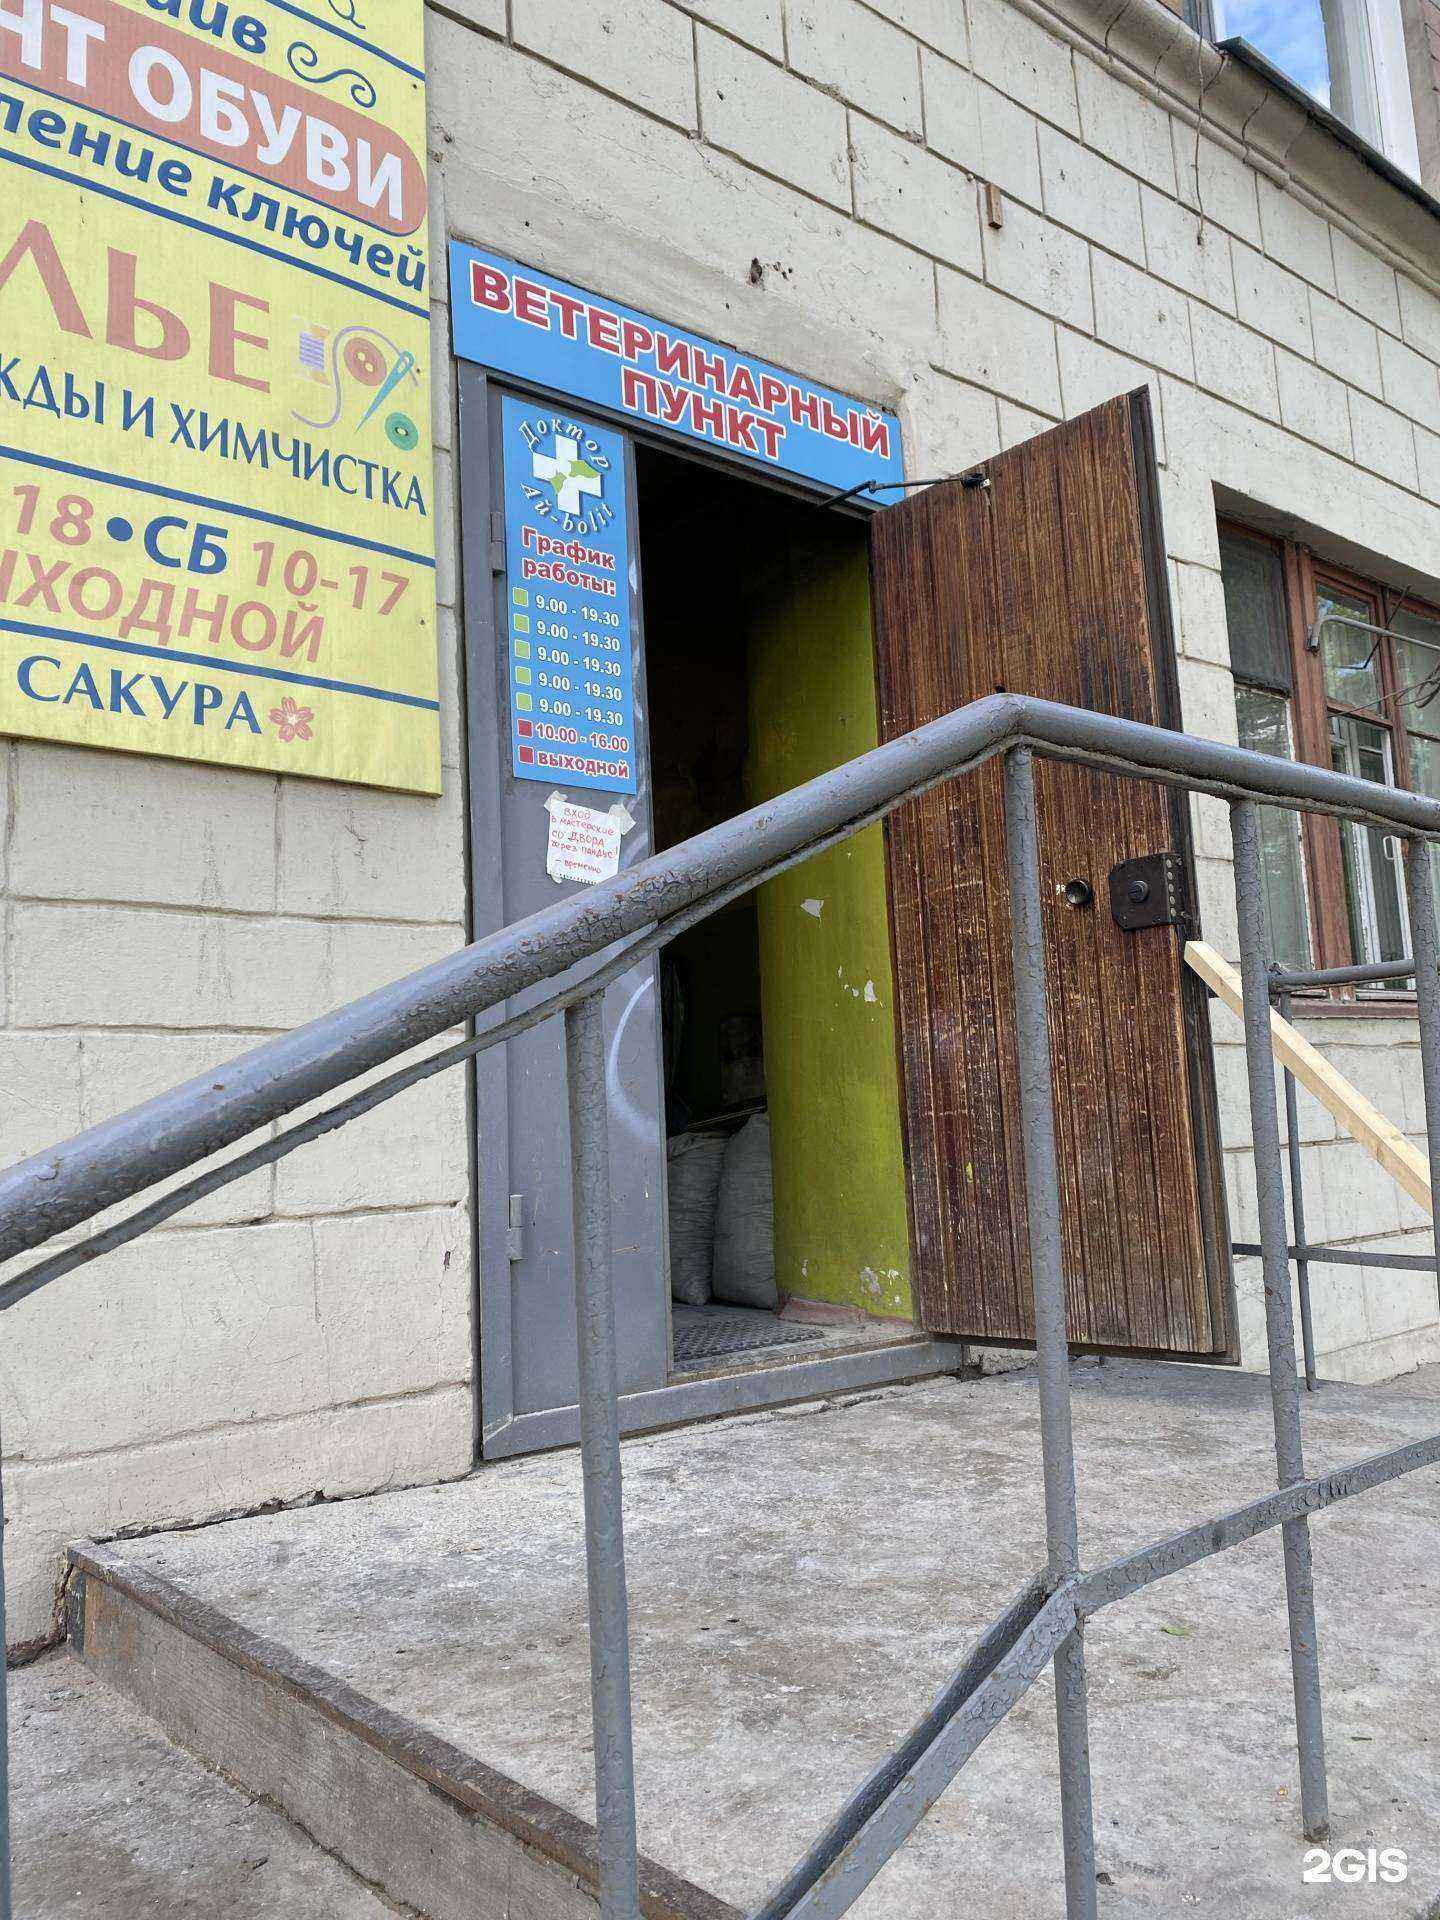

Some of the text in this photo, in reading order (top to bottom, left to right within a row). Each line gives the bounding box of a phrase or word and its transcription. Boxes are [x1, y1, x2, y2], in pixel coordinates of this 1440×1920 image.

[128, 45, 403, 221] ОБУВИ
[207, 175, 425, 293] ключей
[469, 259, 891, 460] ВЕТЕРИНАРНЫЙ
[621, 366, 786, 459] ПУНКТ
[122, 388, 155, 438] И
[169, 402, 428, 516] ХИМЧИСТКА
[518, 417, 609, 468] Доктор
[522, 525, 615, 571] График
[252, 541, 410, 617] 10-17
[522, 557, 617, 596] работы:
[535, 594, 567, 615] 9.00
[581, 606, 620, 627] 19.30
[536, 619, 569, 640] 9.00
[582, 631, 621, 652] 19.30
[537, 645, 570, 666] 9.00
[582, 656, 622, 677] 19.30
[17, 654, 263, 735] САКУРА
[538, 671, 571, 691] 9.00
[584, 682, 623, 702] 19.30
[539, 698, 572, 717] 9.00
[585, 707, 624, 727] 19.30
[535, 723, 577, 744] 10.00
[590, 731, 630, 752] 16.00
